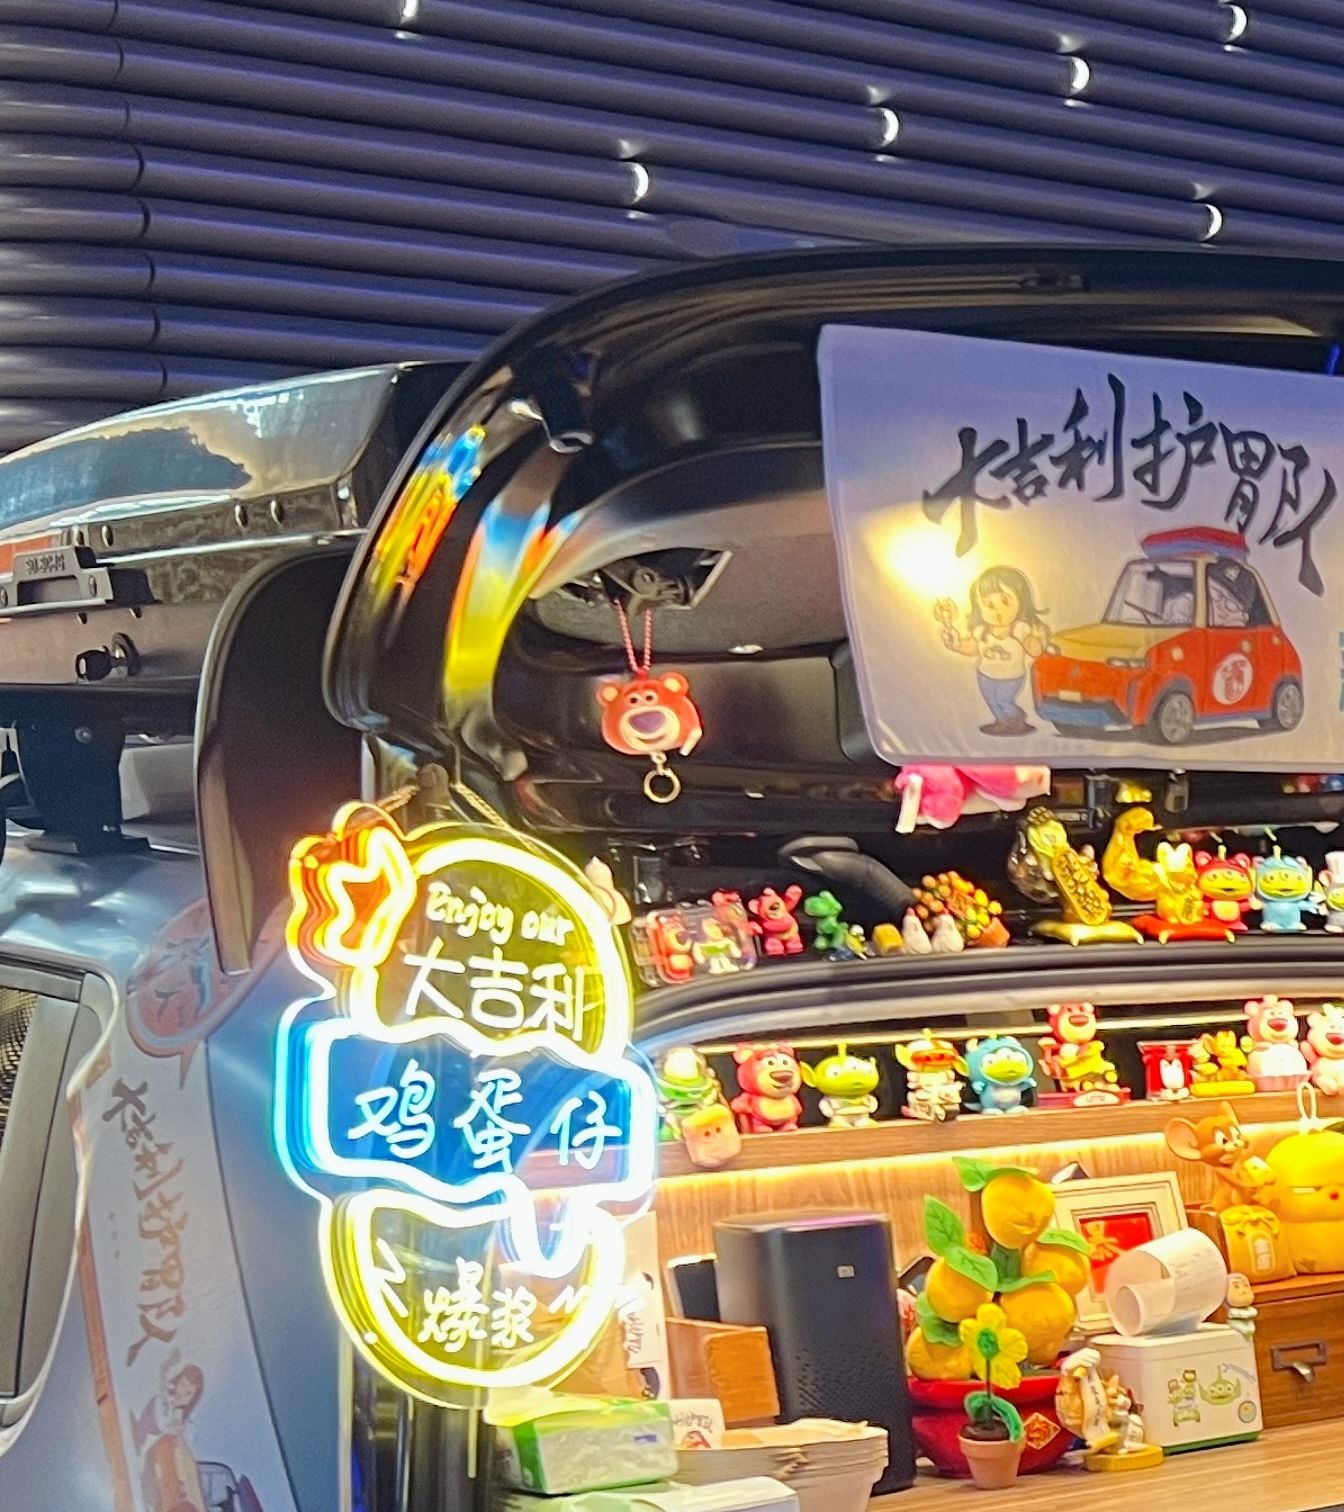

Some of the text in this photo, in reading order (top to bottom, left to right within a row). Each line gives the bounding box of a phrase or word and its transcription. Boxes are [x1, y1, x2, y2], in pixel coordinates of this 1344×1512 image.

[922, 372, 1339, 596] 大吉利护胃队
[425, 882, 575, 948] Enjoy our
[403, 937, 587, 1042] 大吉利
[347, 1057, 624, 1174] 鸡蛋仔
[418, 1256, 535, 1353] 爆浆
